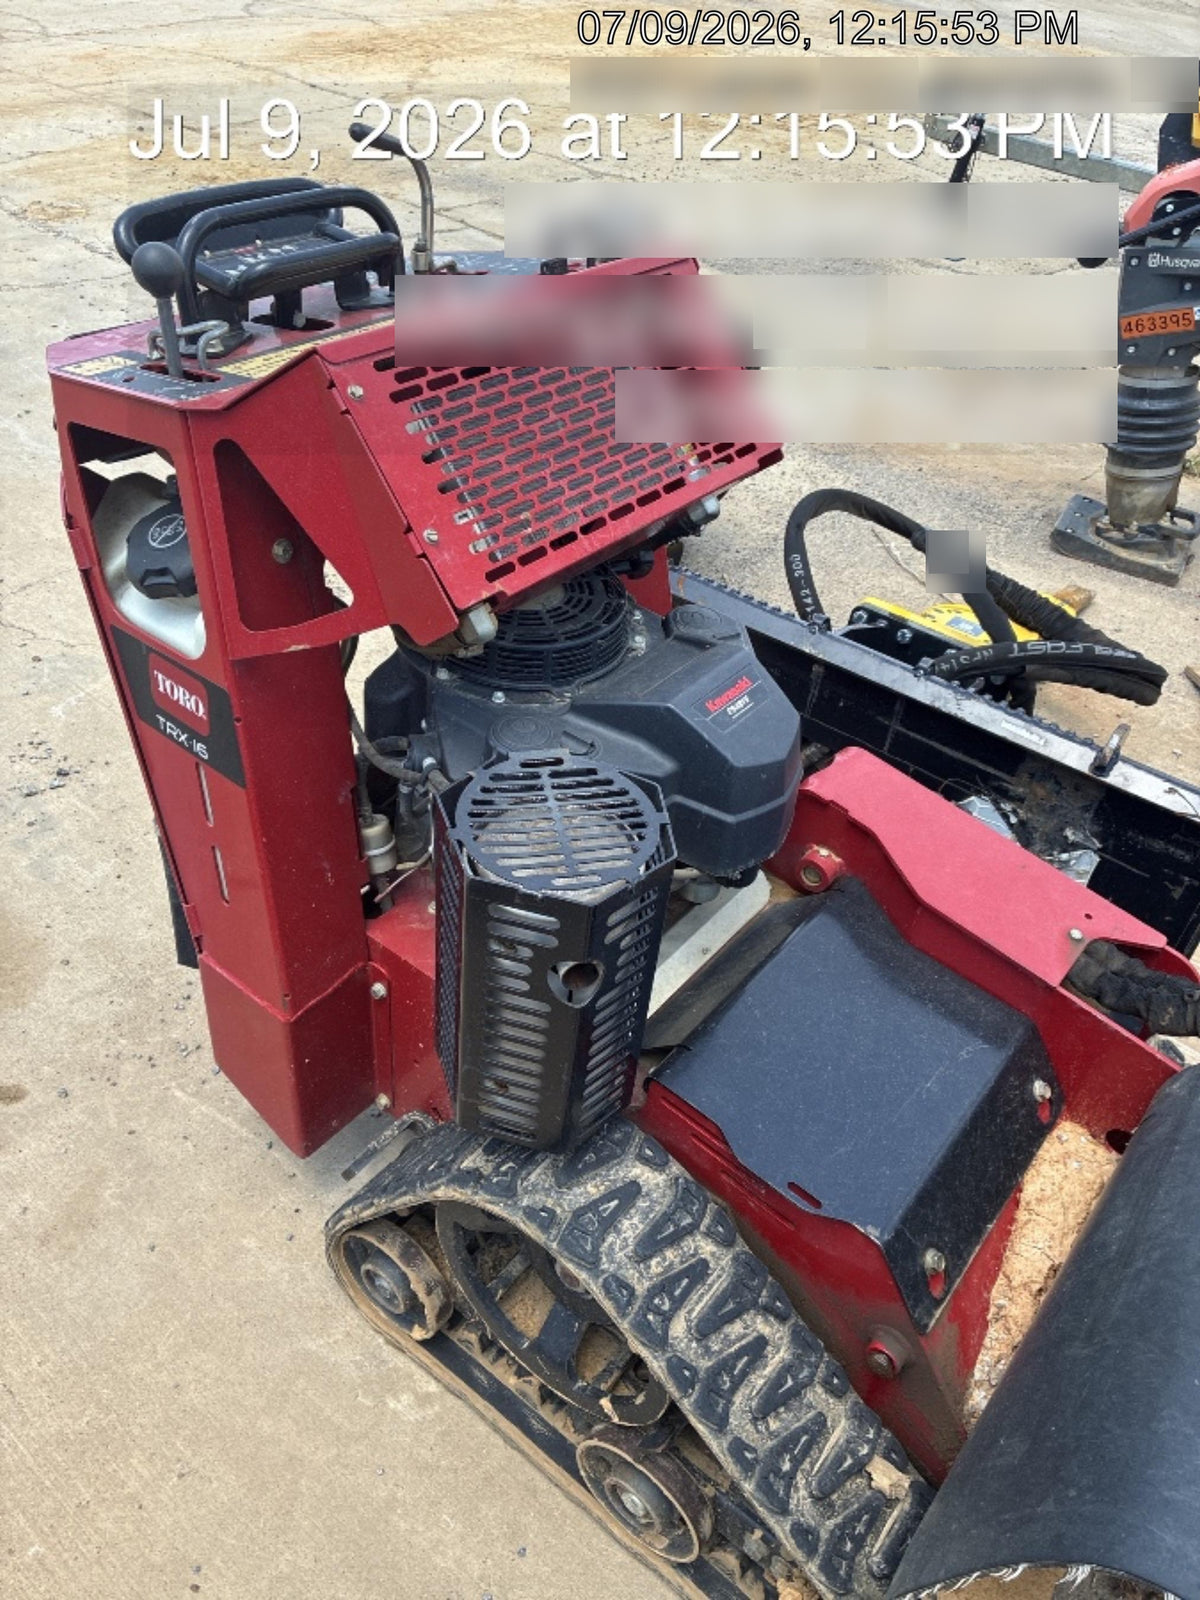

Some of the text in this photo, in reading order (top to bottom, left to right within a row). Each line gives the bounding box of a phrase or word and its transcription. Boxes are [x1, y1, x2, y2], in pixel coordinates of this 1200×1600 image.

[1122, 312, 1193, 334] 463395
[154, 670, 206, 718] TORO
[156, 714, 209, 760] TRX-16
